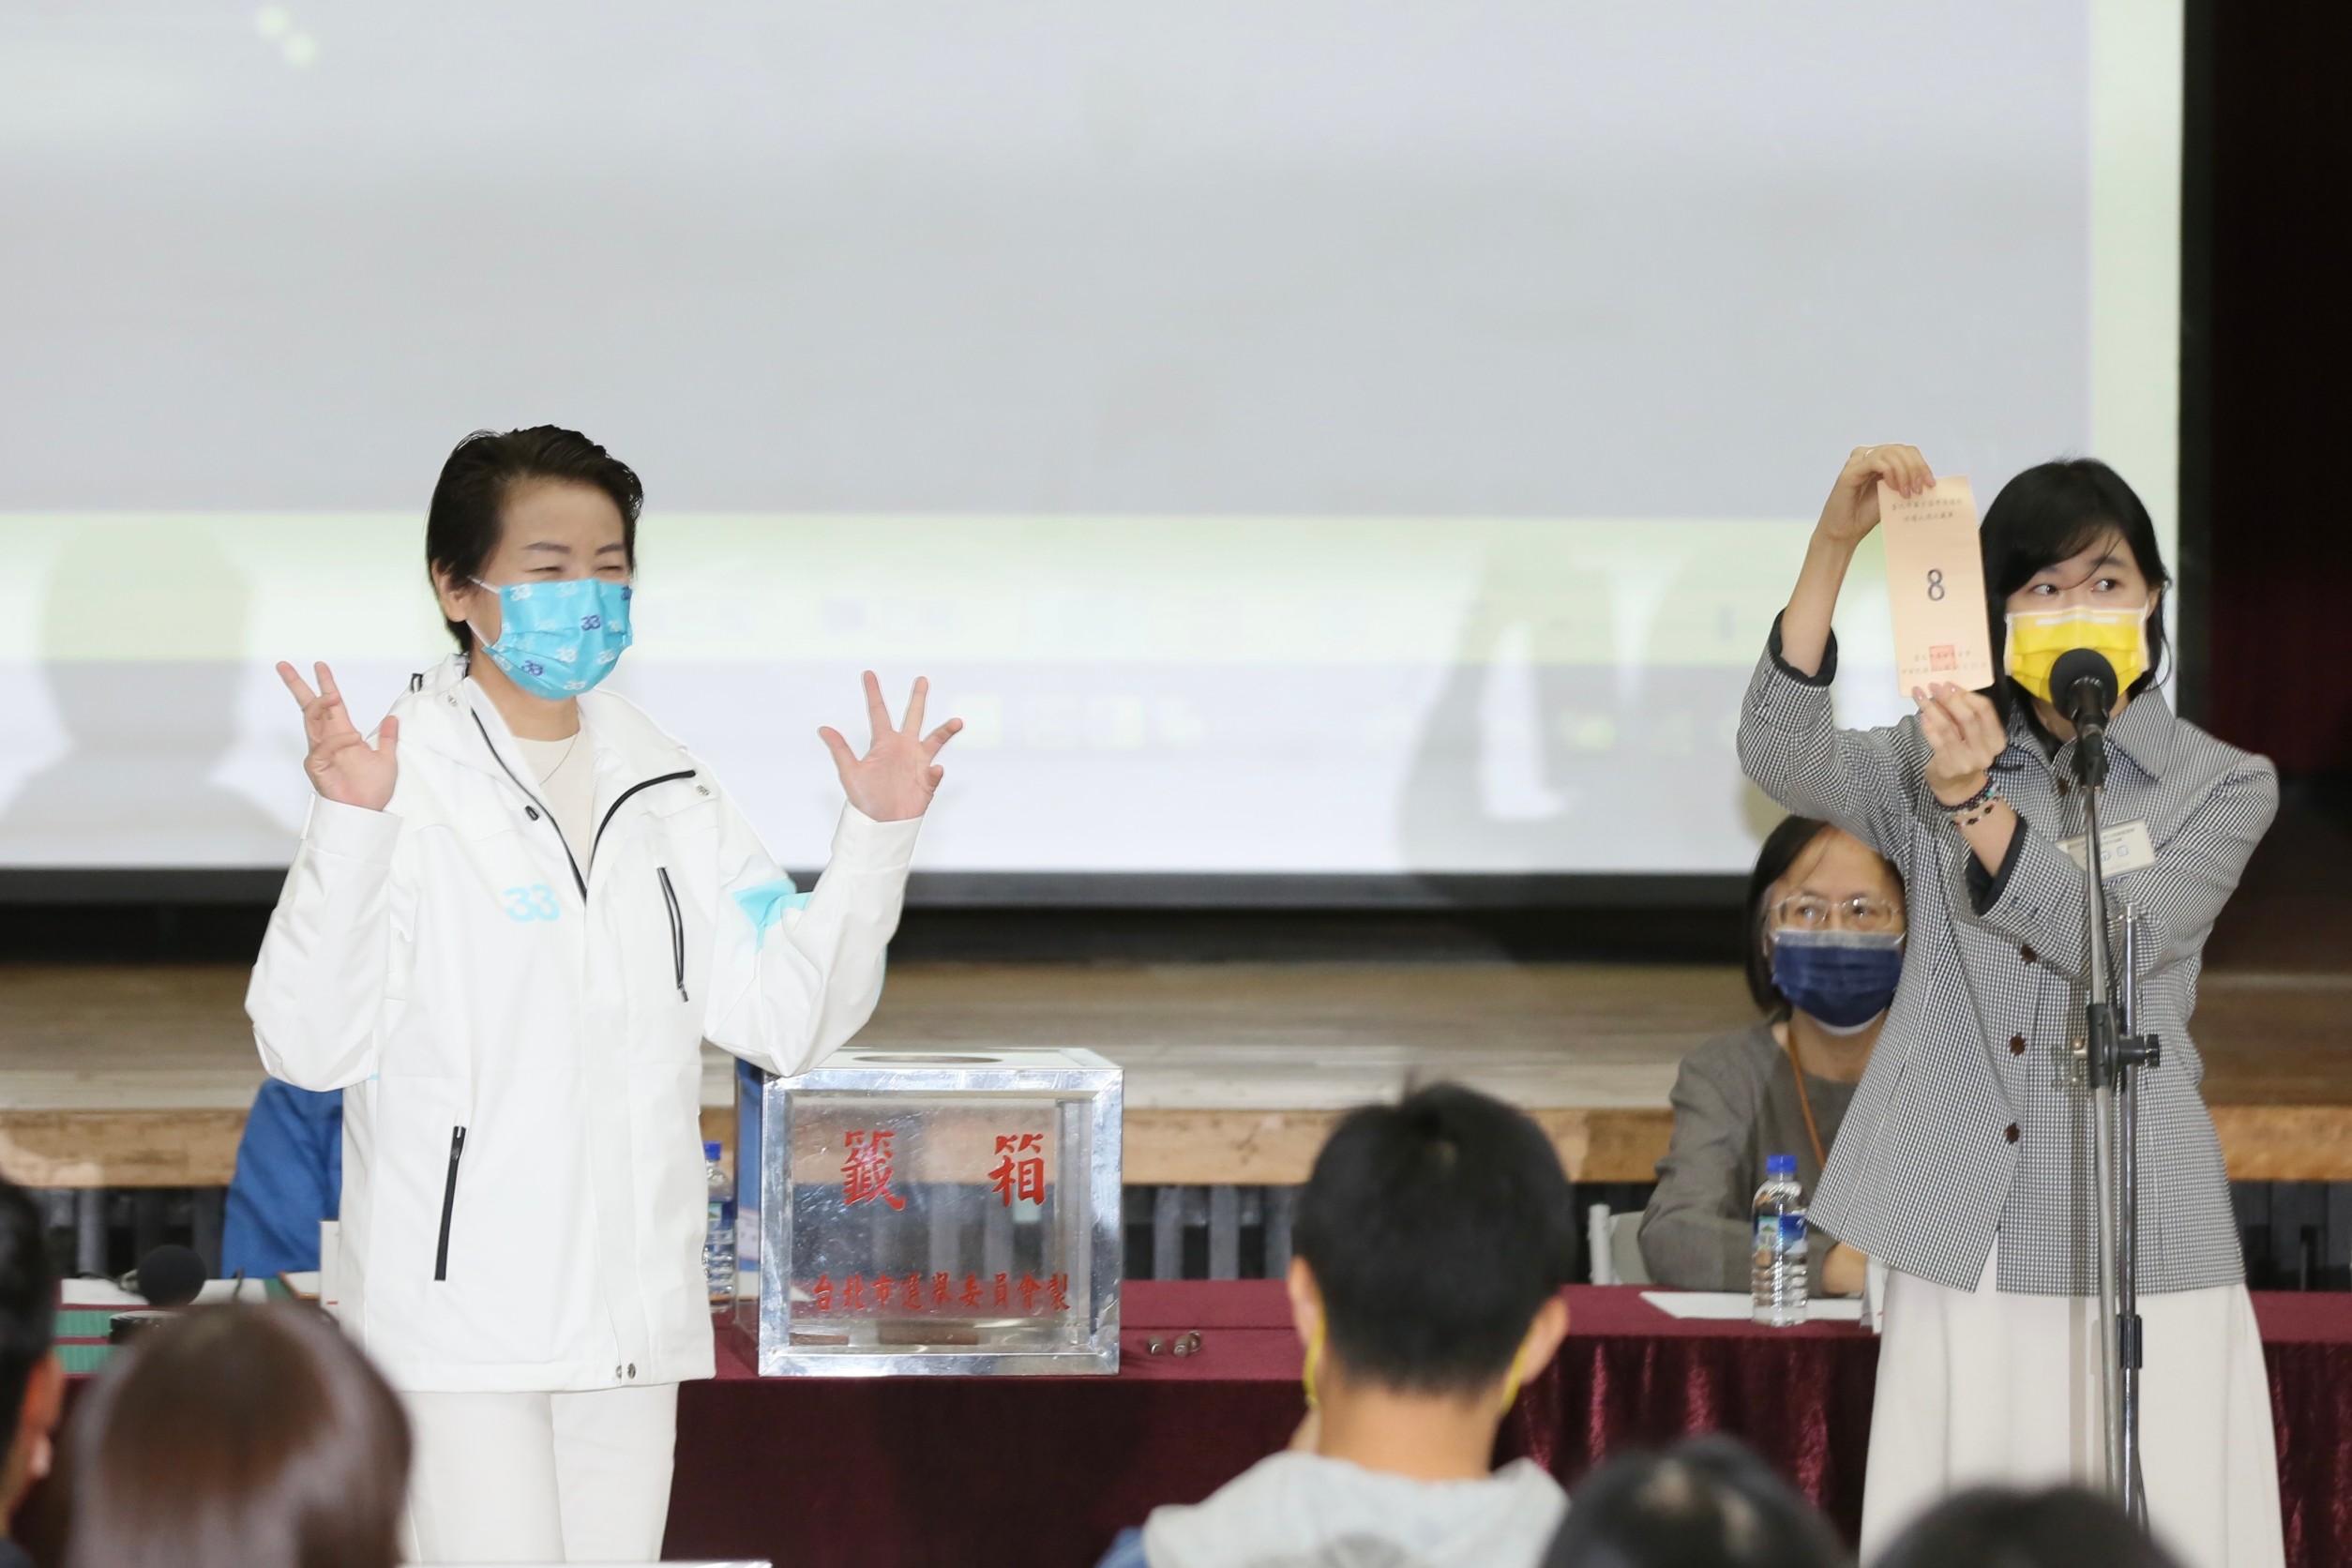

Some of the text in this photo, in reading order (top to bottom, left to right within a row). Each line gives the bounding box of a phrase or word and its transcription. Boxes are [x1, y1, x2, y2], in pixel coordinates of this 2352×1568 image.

[1926, 568, 1945, 601] 8
[580, 614, 601, 631] 33
[503, 883, 562, 923] 33
